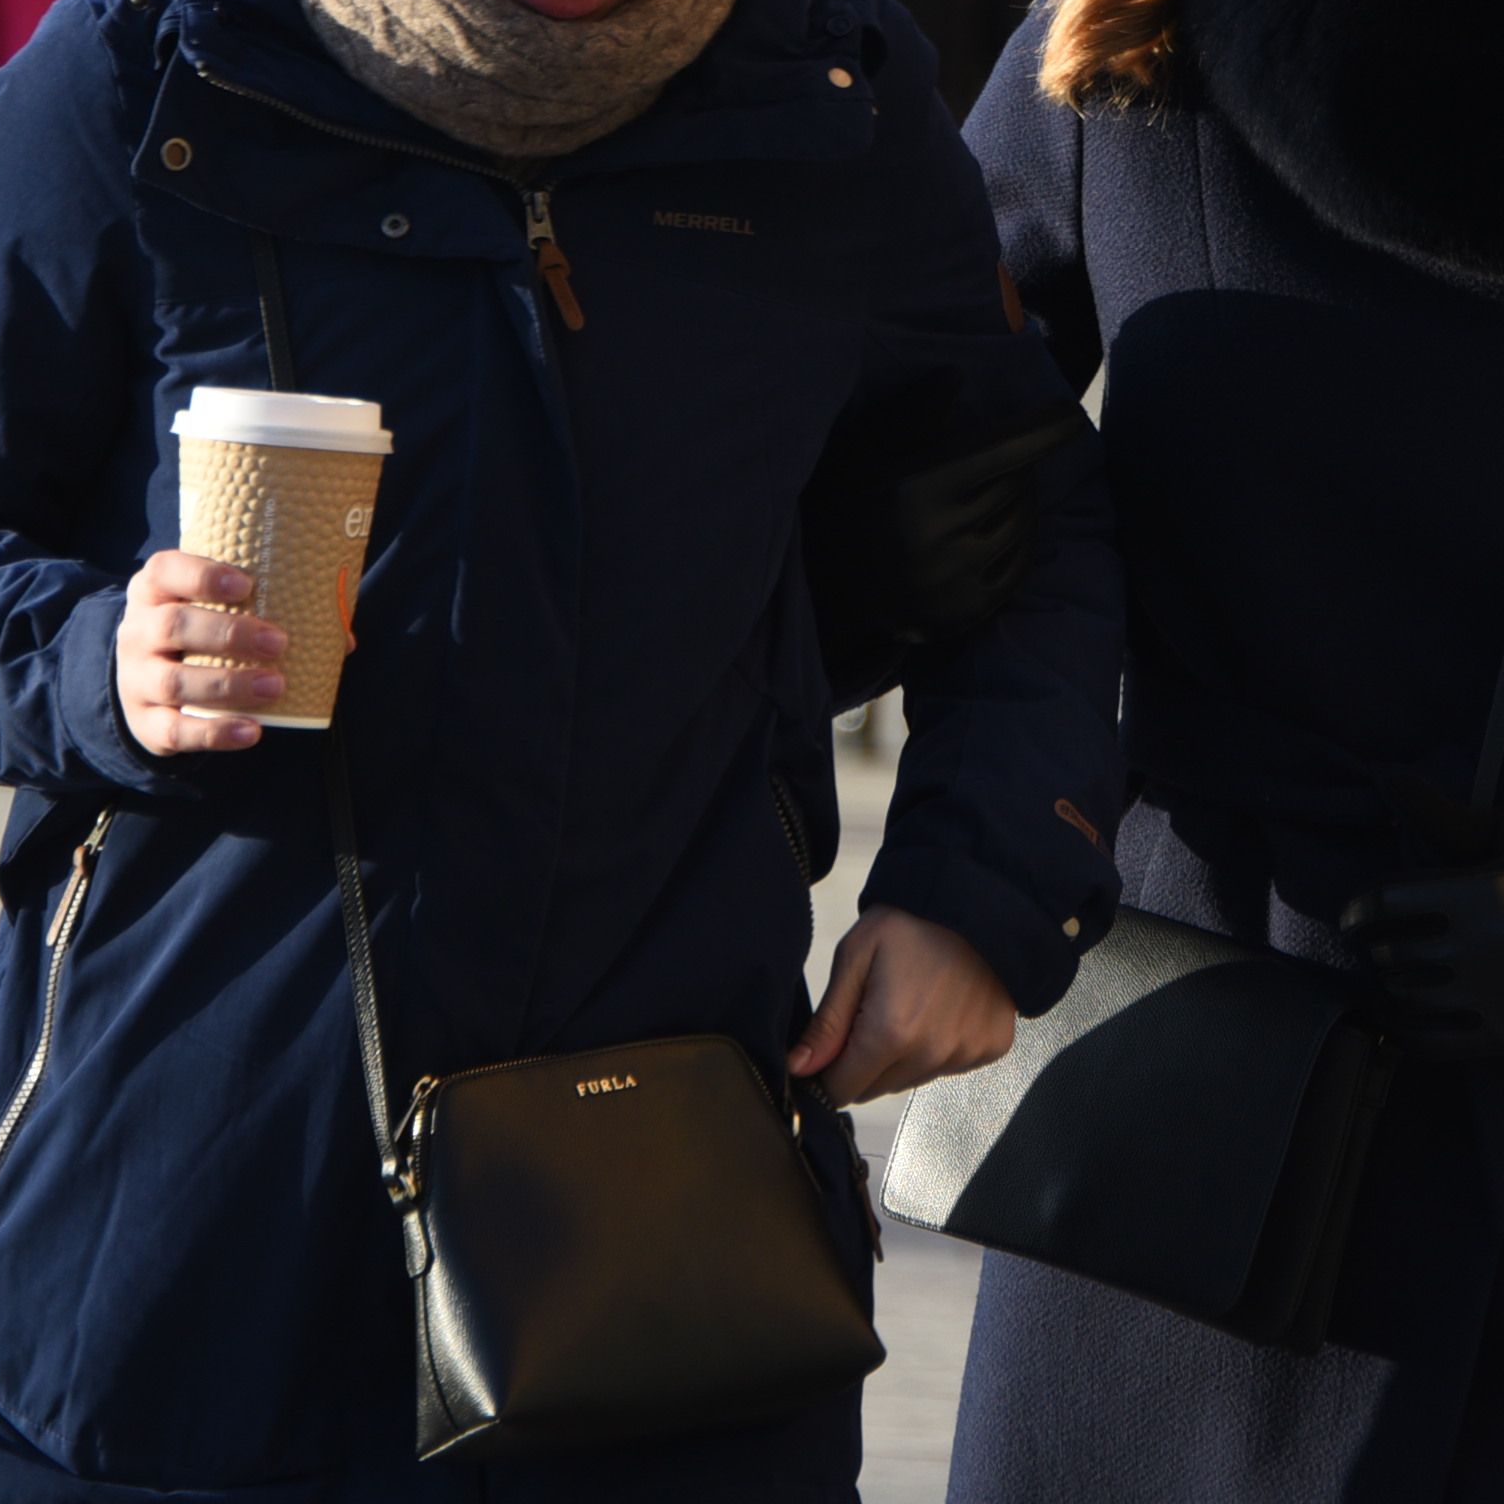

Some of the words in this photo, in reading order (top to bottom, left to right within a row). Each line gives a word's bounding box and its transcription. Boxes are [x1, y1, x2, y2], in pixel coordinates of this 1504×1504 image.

[655, 211, 754, 235] MERRELL
[263, 498, 275, 545] CAUTION
[577, 1074, 637, 1096] FURLA
